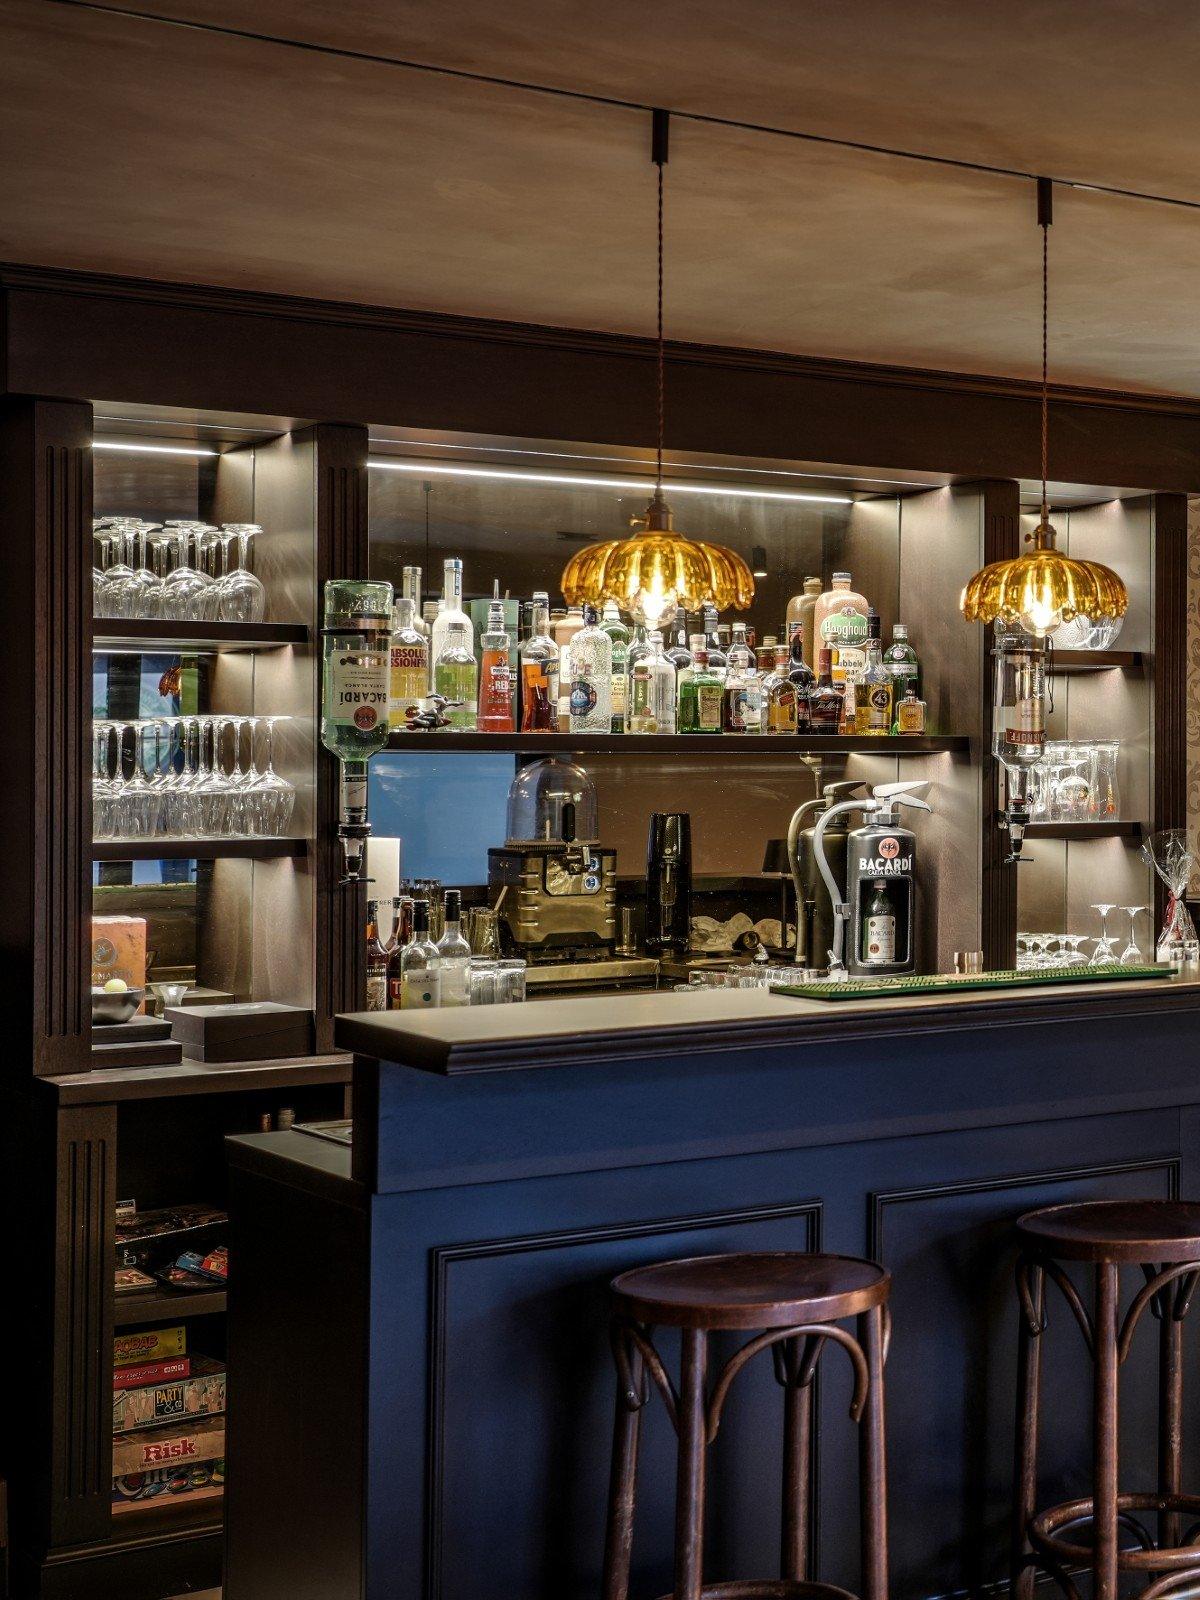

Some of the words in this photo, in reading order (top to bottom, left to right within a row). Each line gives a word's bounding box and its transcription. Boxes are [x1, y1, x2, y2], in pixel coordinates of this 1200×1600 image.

[826, 621, 867, 638] Hooghoud
[339, 692, 387, 706] BACARDÍ
[875, 692, 888, 704] 43
[859, 853, 913, 871] BACARDÍ
[114, 1335, 158, 1352] AOBAB
[156, 1386, 184, 1403] PARTY
[164, 1400, 175, 1413] &
[143, 1438, 196, 1463] Risk
